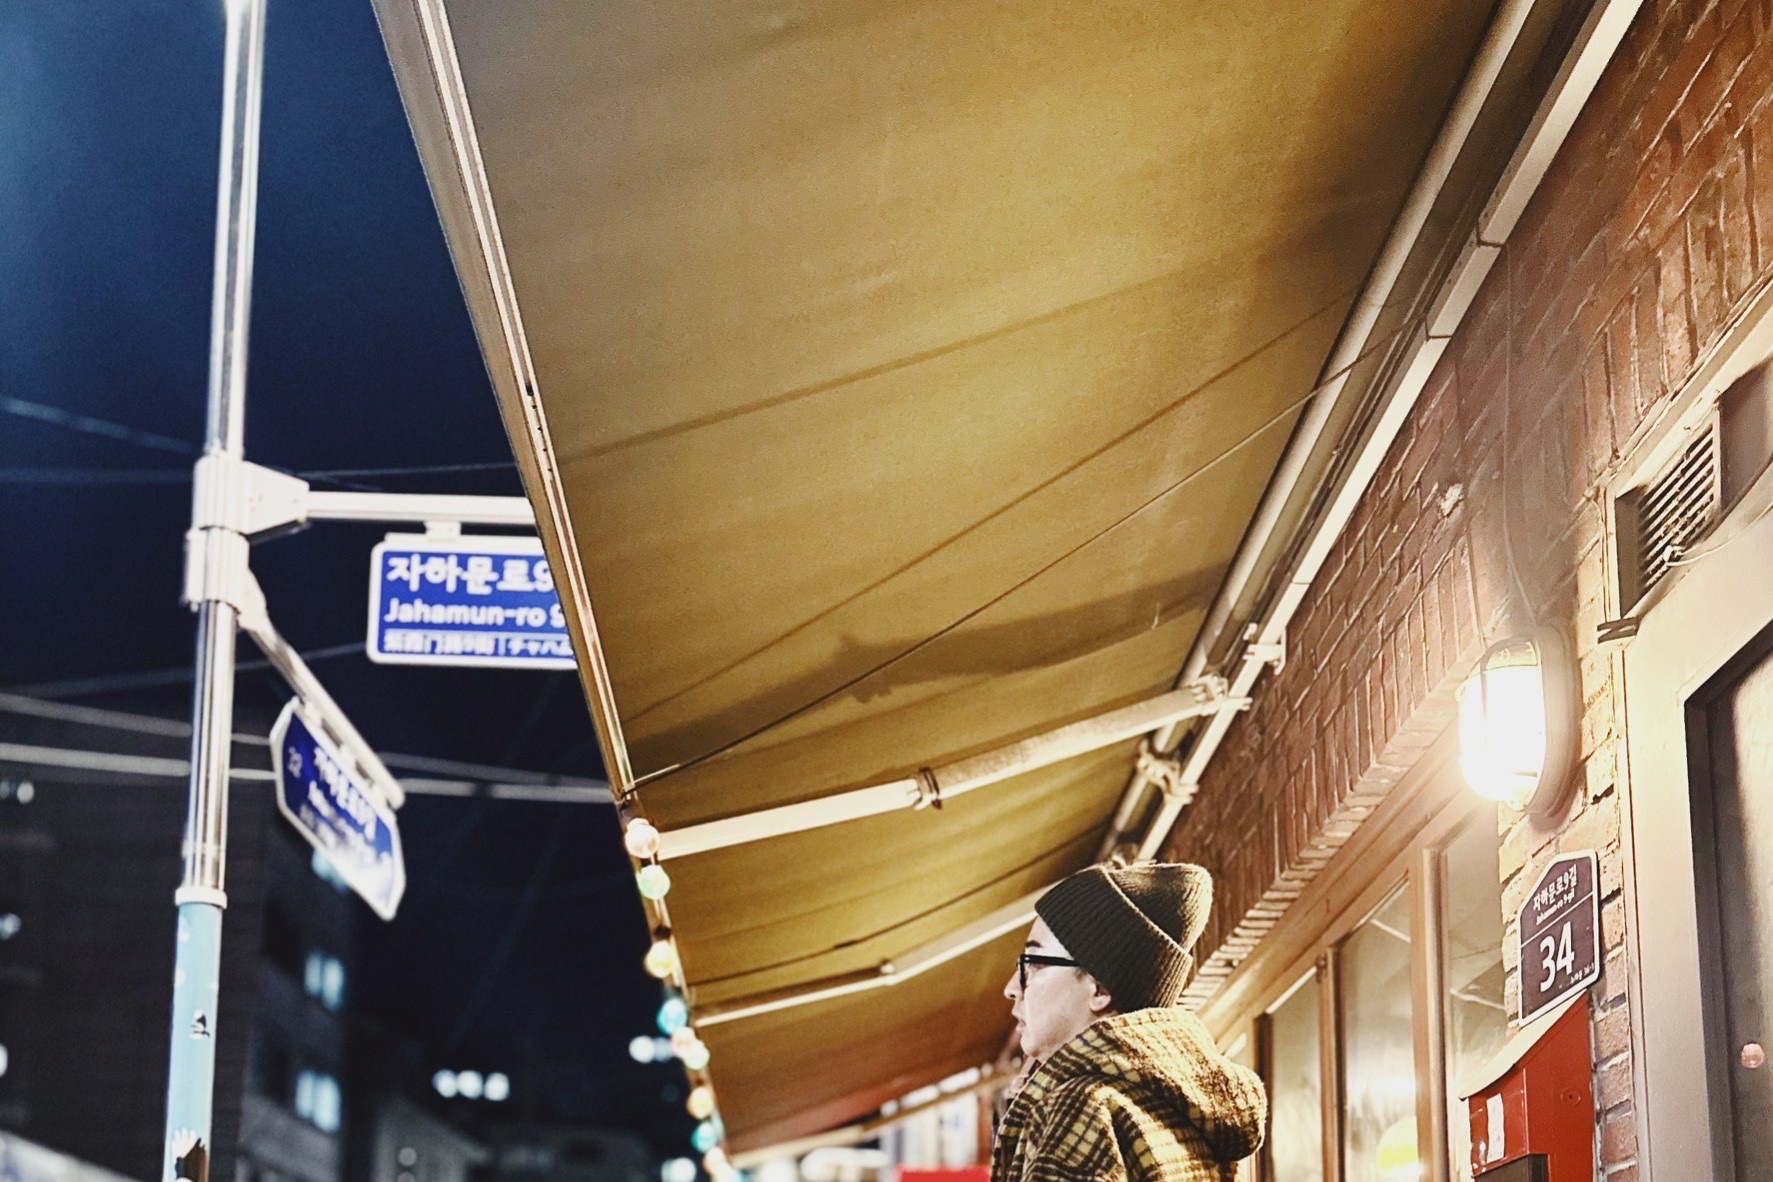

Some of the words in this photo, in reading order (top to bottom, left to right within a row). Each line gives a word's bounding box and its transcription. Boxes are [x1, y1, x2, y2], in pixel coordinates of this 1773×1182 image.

[384, 597, 547, 627] Jahamun-ro
[1533, 863, 1577, 911] 자하문로9길
[1540, 920, 1575, 992] 34
